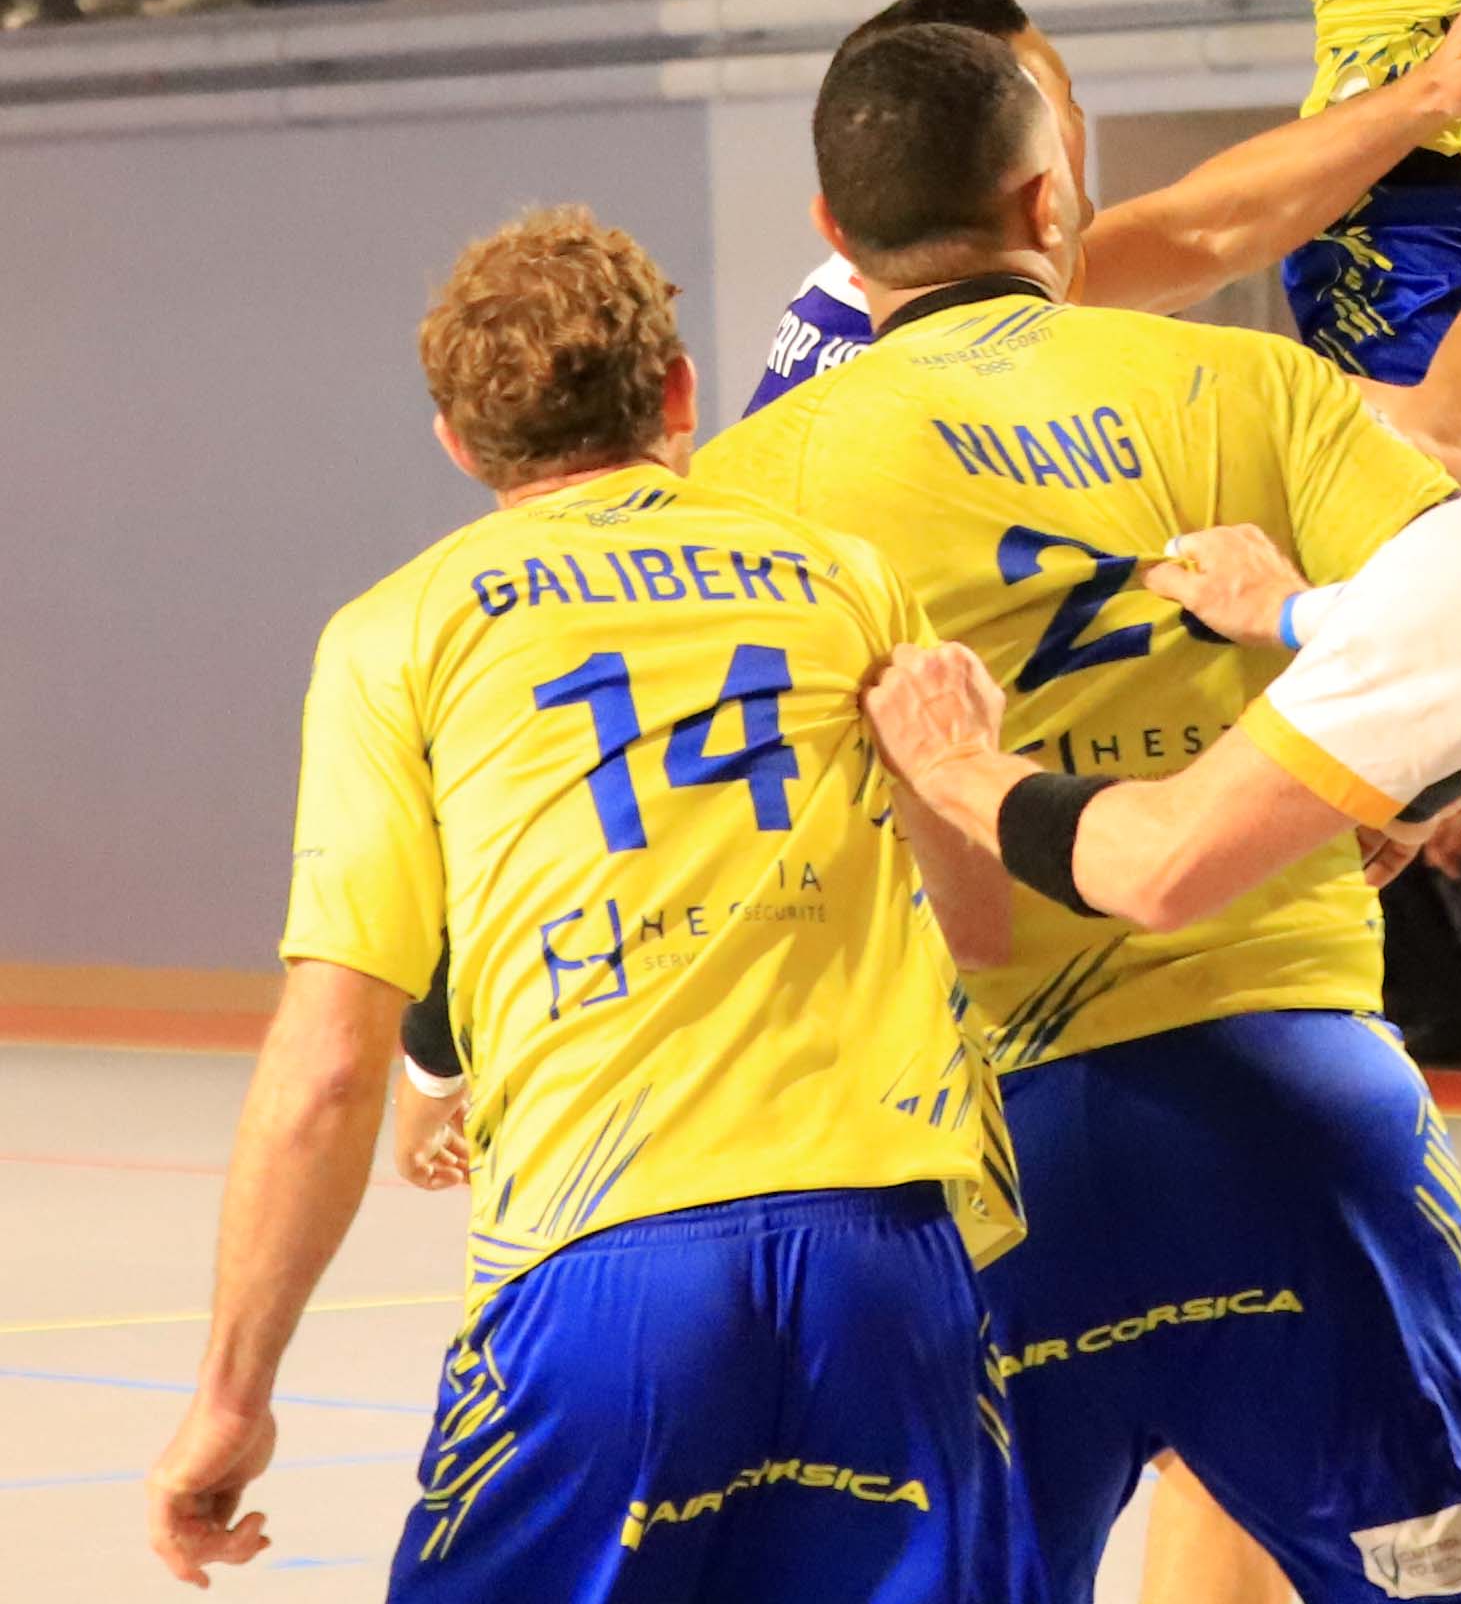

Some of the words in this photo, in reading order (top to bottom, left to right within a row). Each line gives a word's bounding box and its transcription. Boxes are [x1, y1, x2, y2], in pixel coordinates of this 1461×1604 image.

[932, 405, 1144, 490] NIANG
[471, 546, 819, 617] GALIBERT
[533, 643, 801, 856] 14
[998, 1338, 1070, 1379] AIR
[1076, 1288, 1304, 1353] CORSICA
